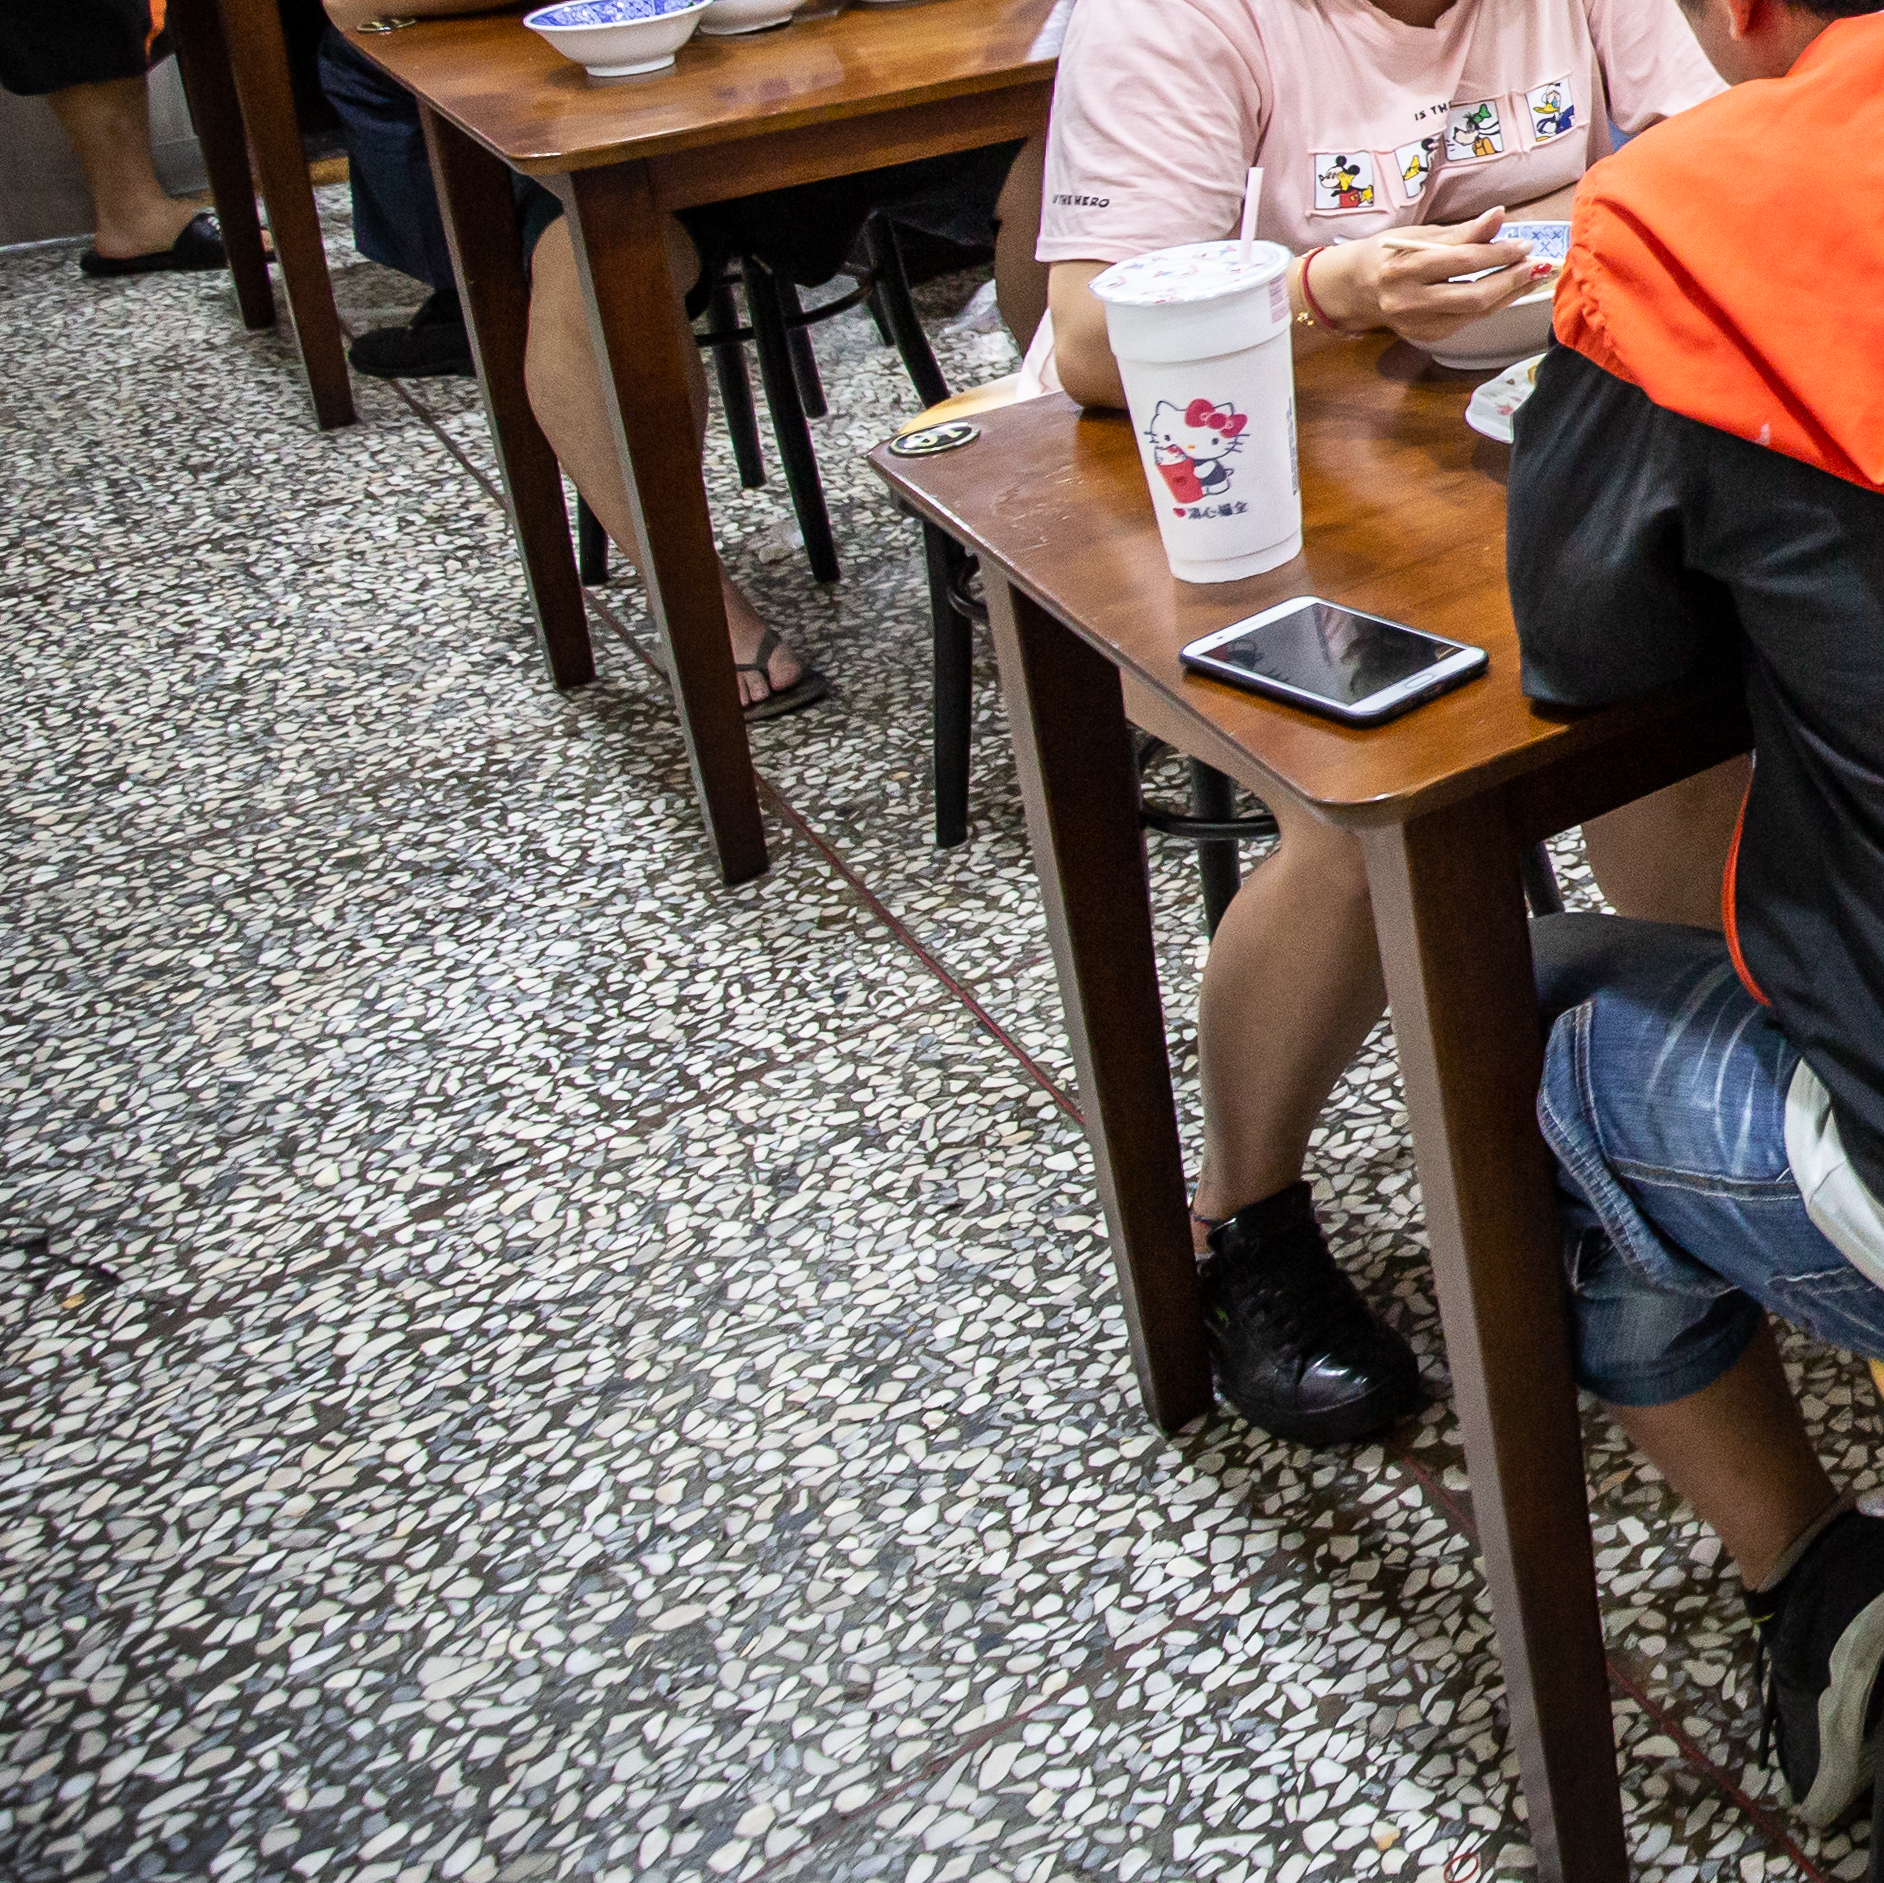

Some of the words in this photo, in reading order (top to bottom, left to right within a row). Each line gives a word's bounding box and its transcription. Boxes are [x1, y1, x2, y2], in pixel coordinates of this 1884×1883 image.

[1414, 109, 1427, 121] IS
[1430, 101, 1450, 115] TH
[1073, 195, 1110, 208] HERO
